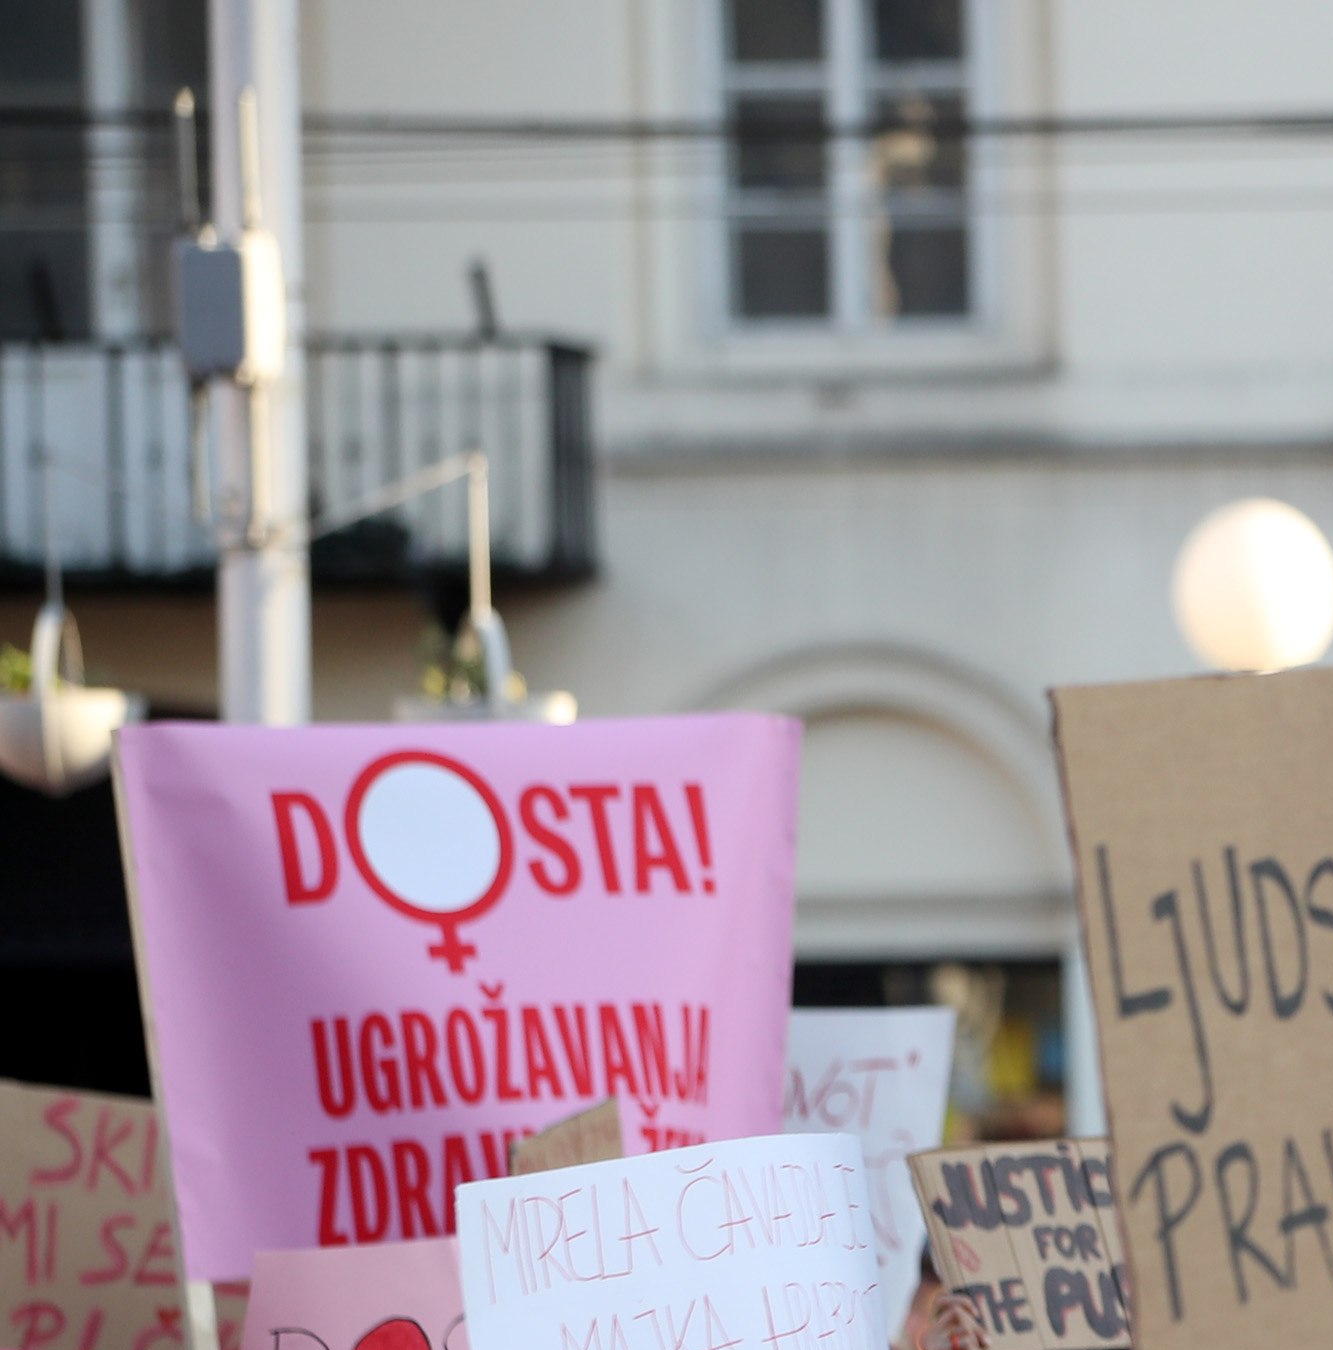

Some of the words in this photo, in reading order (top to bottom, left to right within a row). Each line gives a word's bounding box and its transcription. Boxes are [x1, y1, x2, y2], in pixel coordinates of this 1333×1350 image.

[271, 750, 718, 922] DOSTA!
[310, 983, 710, 1118] UGROŽAVANJA
[80, 1211, 178, 1287] SE
[482, 1177, 663, 1305] MIRELA
[1034, 1224, 1102, 1263] FOR
